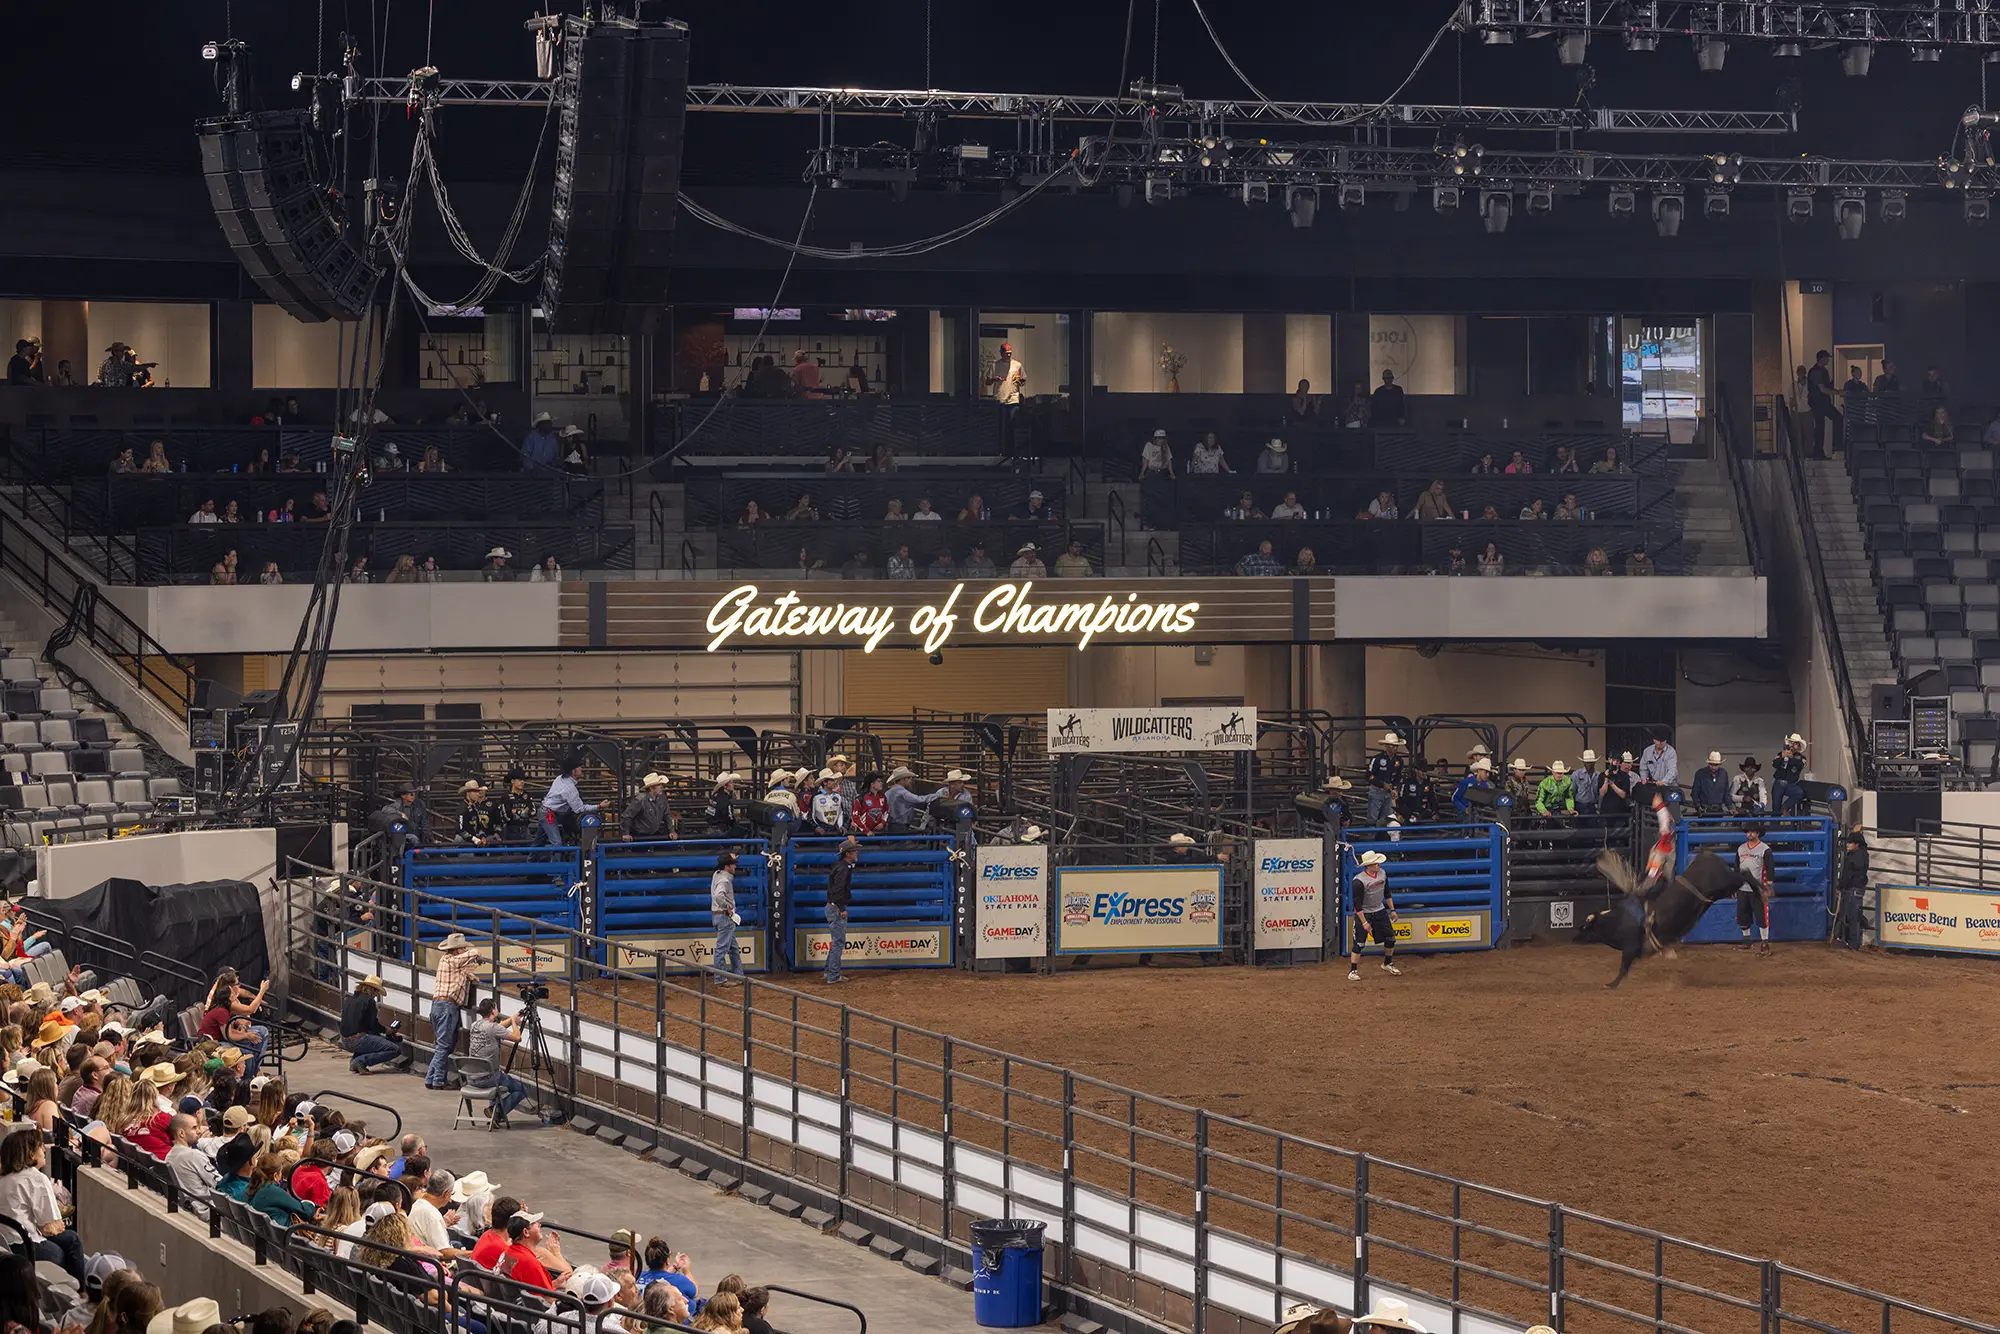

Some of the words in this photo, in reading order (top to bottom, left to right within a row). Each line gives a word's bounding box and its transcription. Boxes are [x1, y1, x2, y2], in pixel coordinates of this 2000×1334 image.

[706, 584, 895, 653] Gateway
[909, 582, 964, 654] of
[973, 581, 1201, 652] Champions
[1112, 716, 1194, 741] WILDCATTERS
[1051, 735, 1090, 748] WILDCATTERS
[1132, 734, 1172, 742] OKLAHOMA
[1213, 733, 1253, 746] WILDCATTERS
[1261, 857, 1315, 873] Express
[983, 864, 1039, 881] Express
[773, 854, 782, 939] Priefert
[958, 851, 967, 934] Priefert
[391, 865, 399, 953] Priefet
[584, 859, 592, 946] Priefert
[1093, 892, 1185, 925] Express
[1144, 917, 1182, 925] PROFESSIONALS
[1265, 918, 1312, 929] GAMEDAY
[1884, 911, 1927, 923] Beavers
[1929, 912, 1957, 928] Bend
[987, 927, 1034, 937] GAMEDAY
[1897, 923, 1917, 932] Cabin
[1918, 923, 1944, 935] Country
[1979, 928, 1999, 938] Cabin
[813, 941, 866, 951] GADAY
[879, 939, 932, 950] GAMEDAY
[507, 956, 532, 964] Beaver
